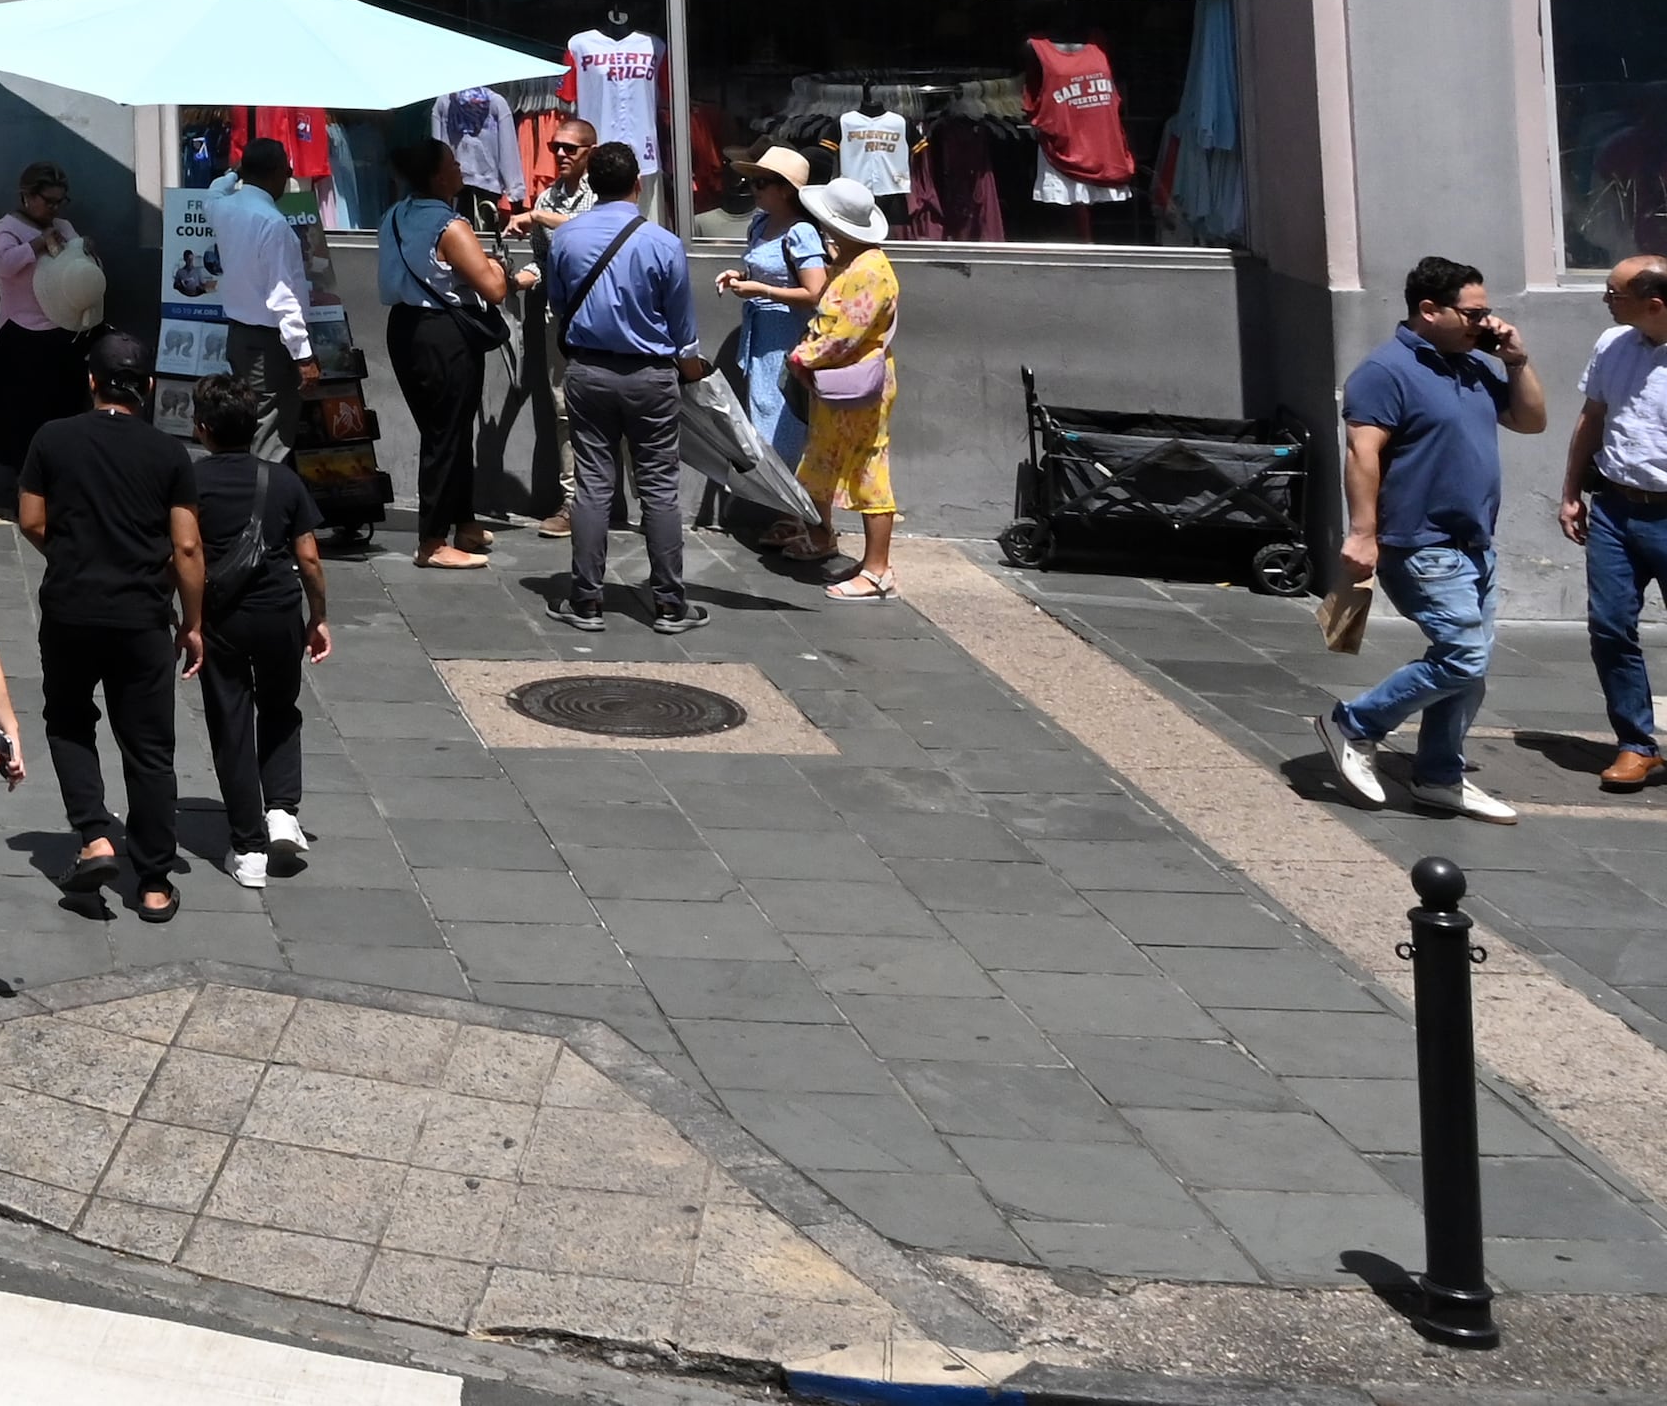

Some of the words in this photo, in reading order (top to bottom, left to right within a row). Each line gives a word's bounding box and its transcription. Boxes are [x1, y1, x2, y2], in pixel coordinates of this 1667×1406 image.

[607, 66, 655, 81] RICO
[1052, 83, 1082, 104] SAN
[865, 141, 896, 153] RICO
